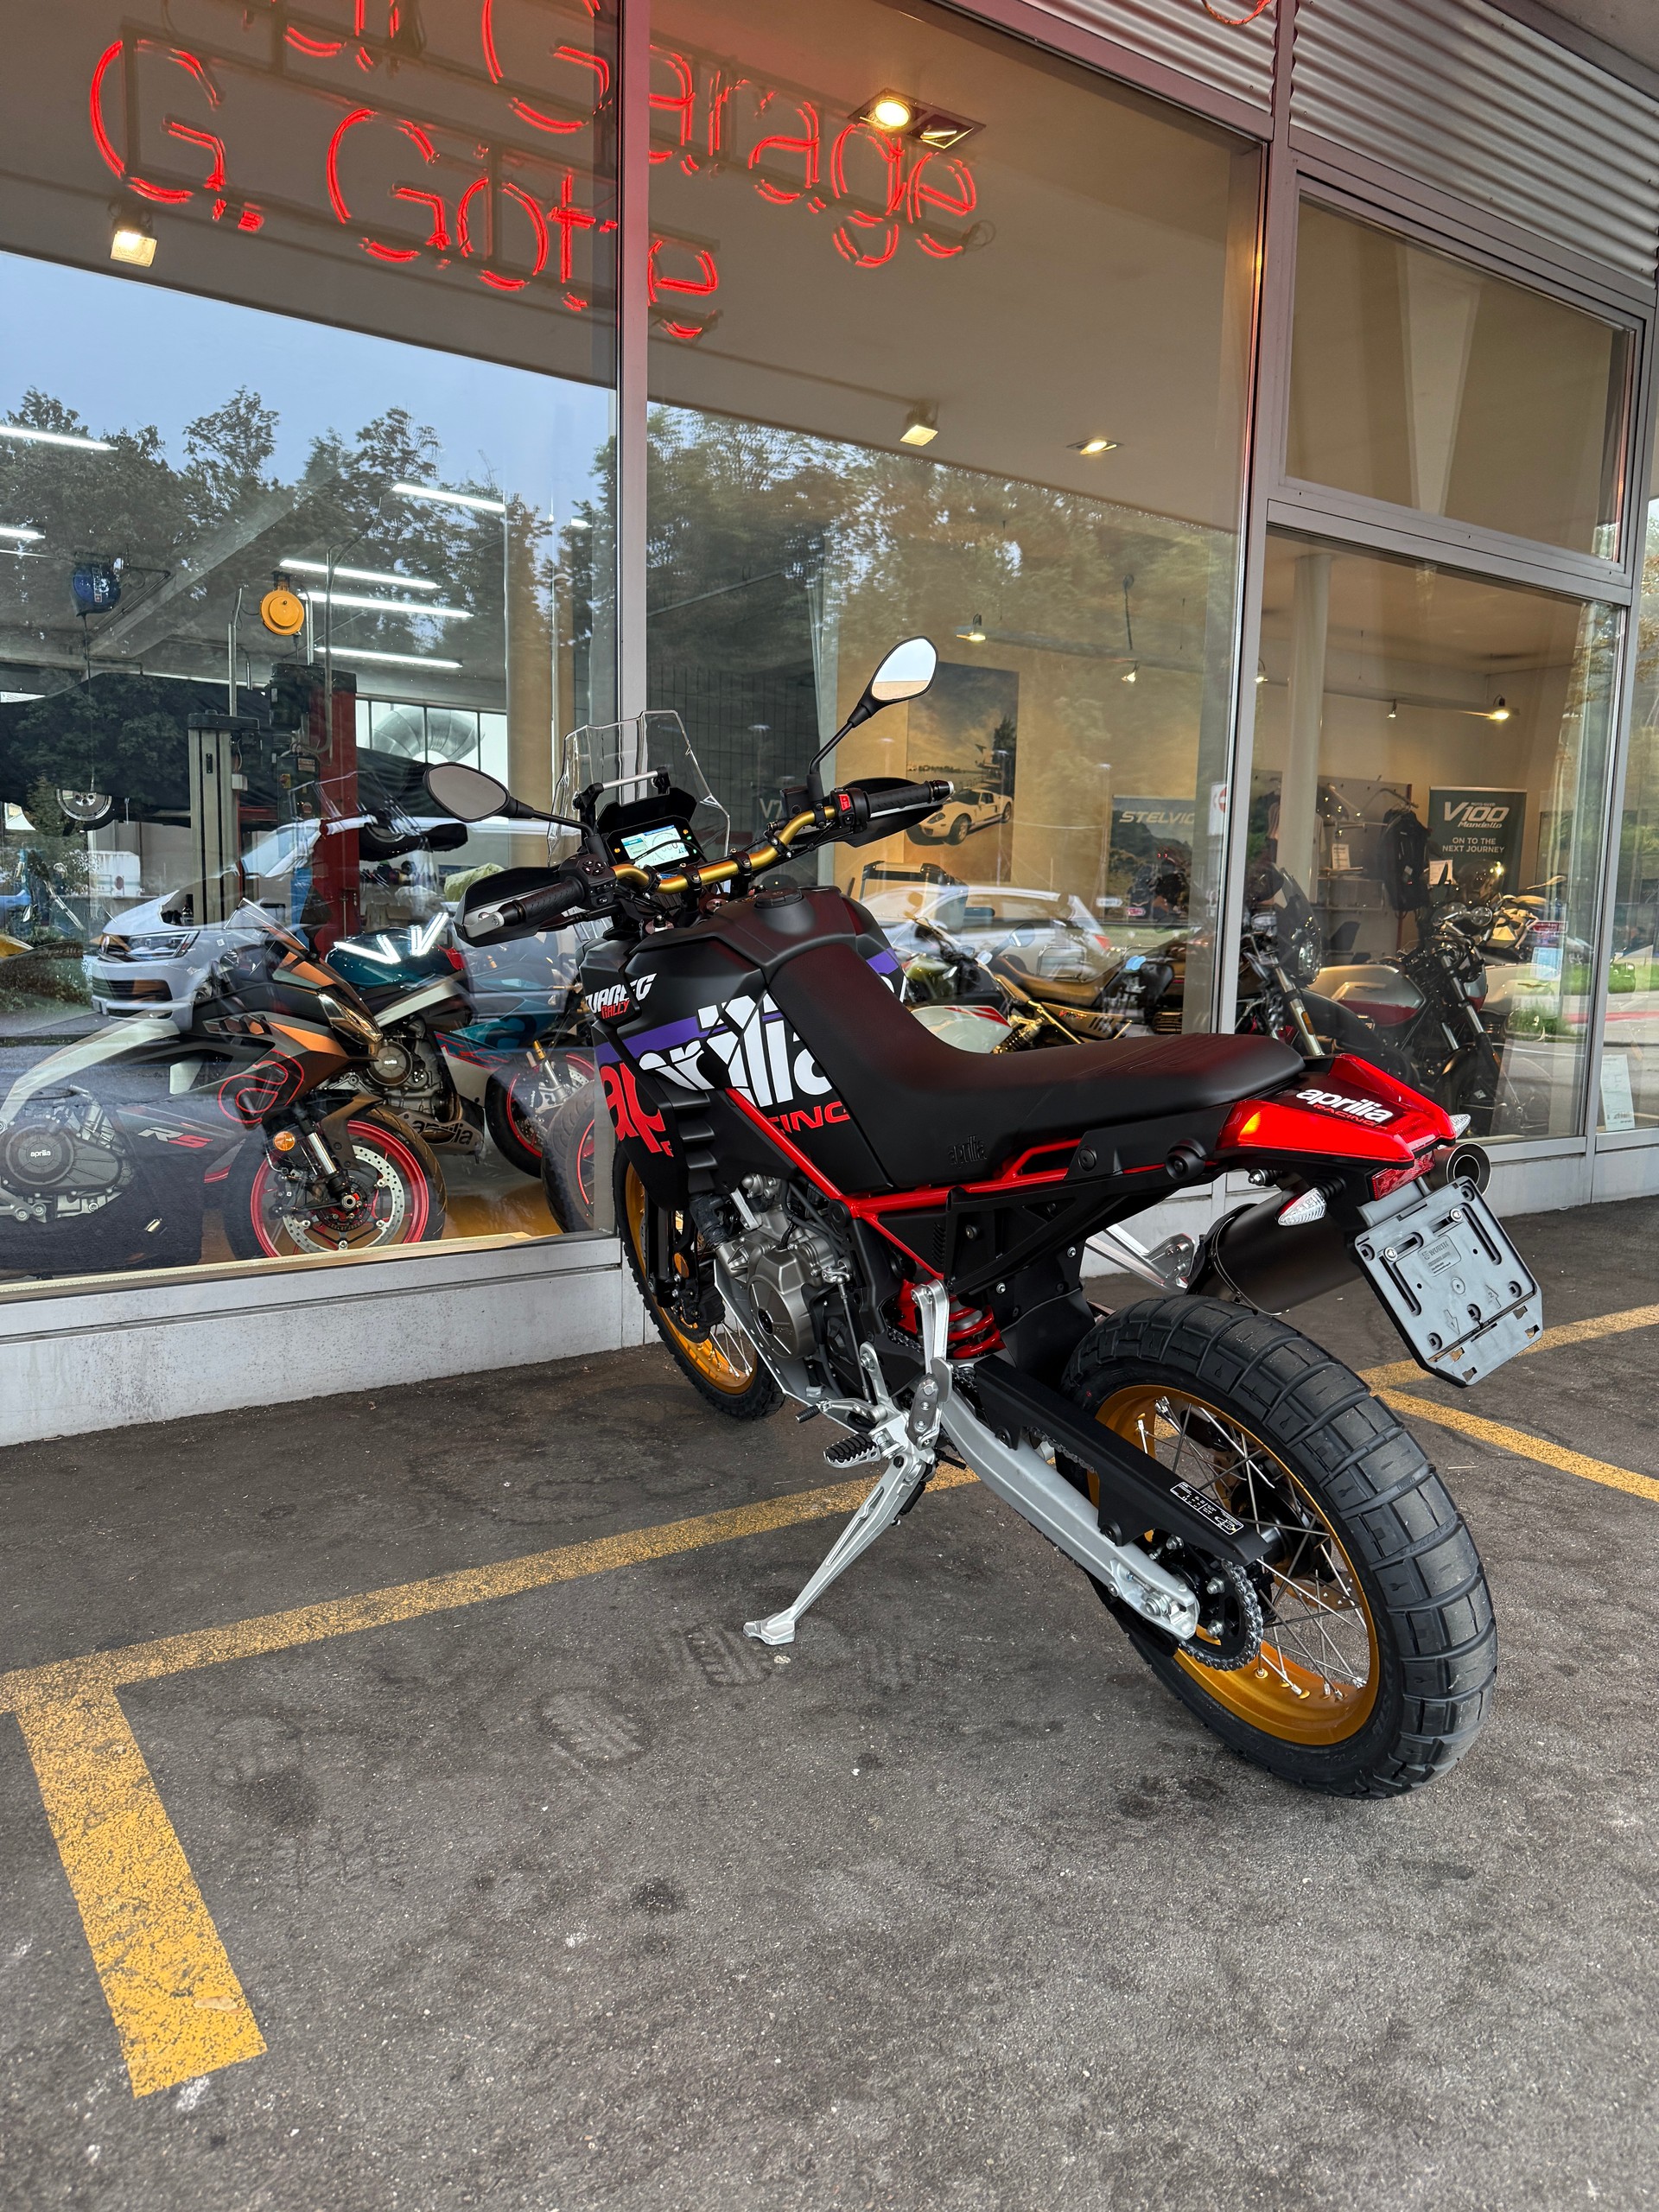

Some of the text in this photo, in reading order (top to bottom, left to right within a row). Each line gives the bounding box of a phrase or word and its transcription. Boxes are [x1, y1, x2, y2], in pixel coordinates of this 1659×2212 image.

[1444, 801, 1510, 822] V100
[585, 973, 657, 1014] UAREG
[601, 1000, 630, 1020] RALLY
[1296, 1089, 1394, 1122] aprilia
[1313, 1104, 1376, 1127] RACING
[138, 1127, 213, 1148] RS
[30, 1149, 51, 1158] aprilia
[947, 1135, 988, 1168] aprilia
